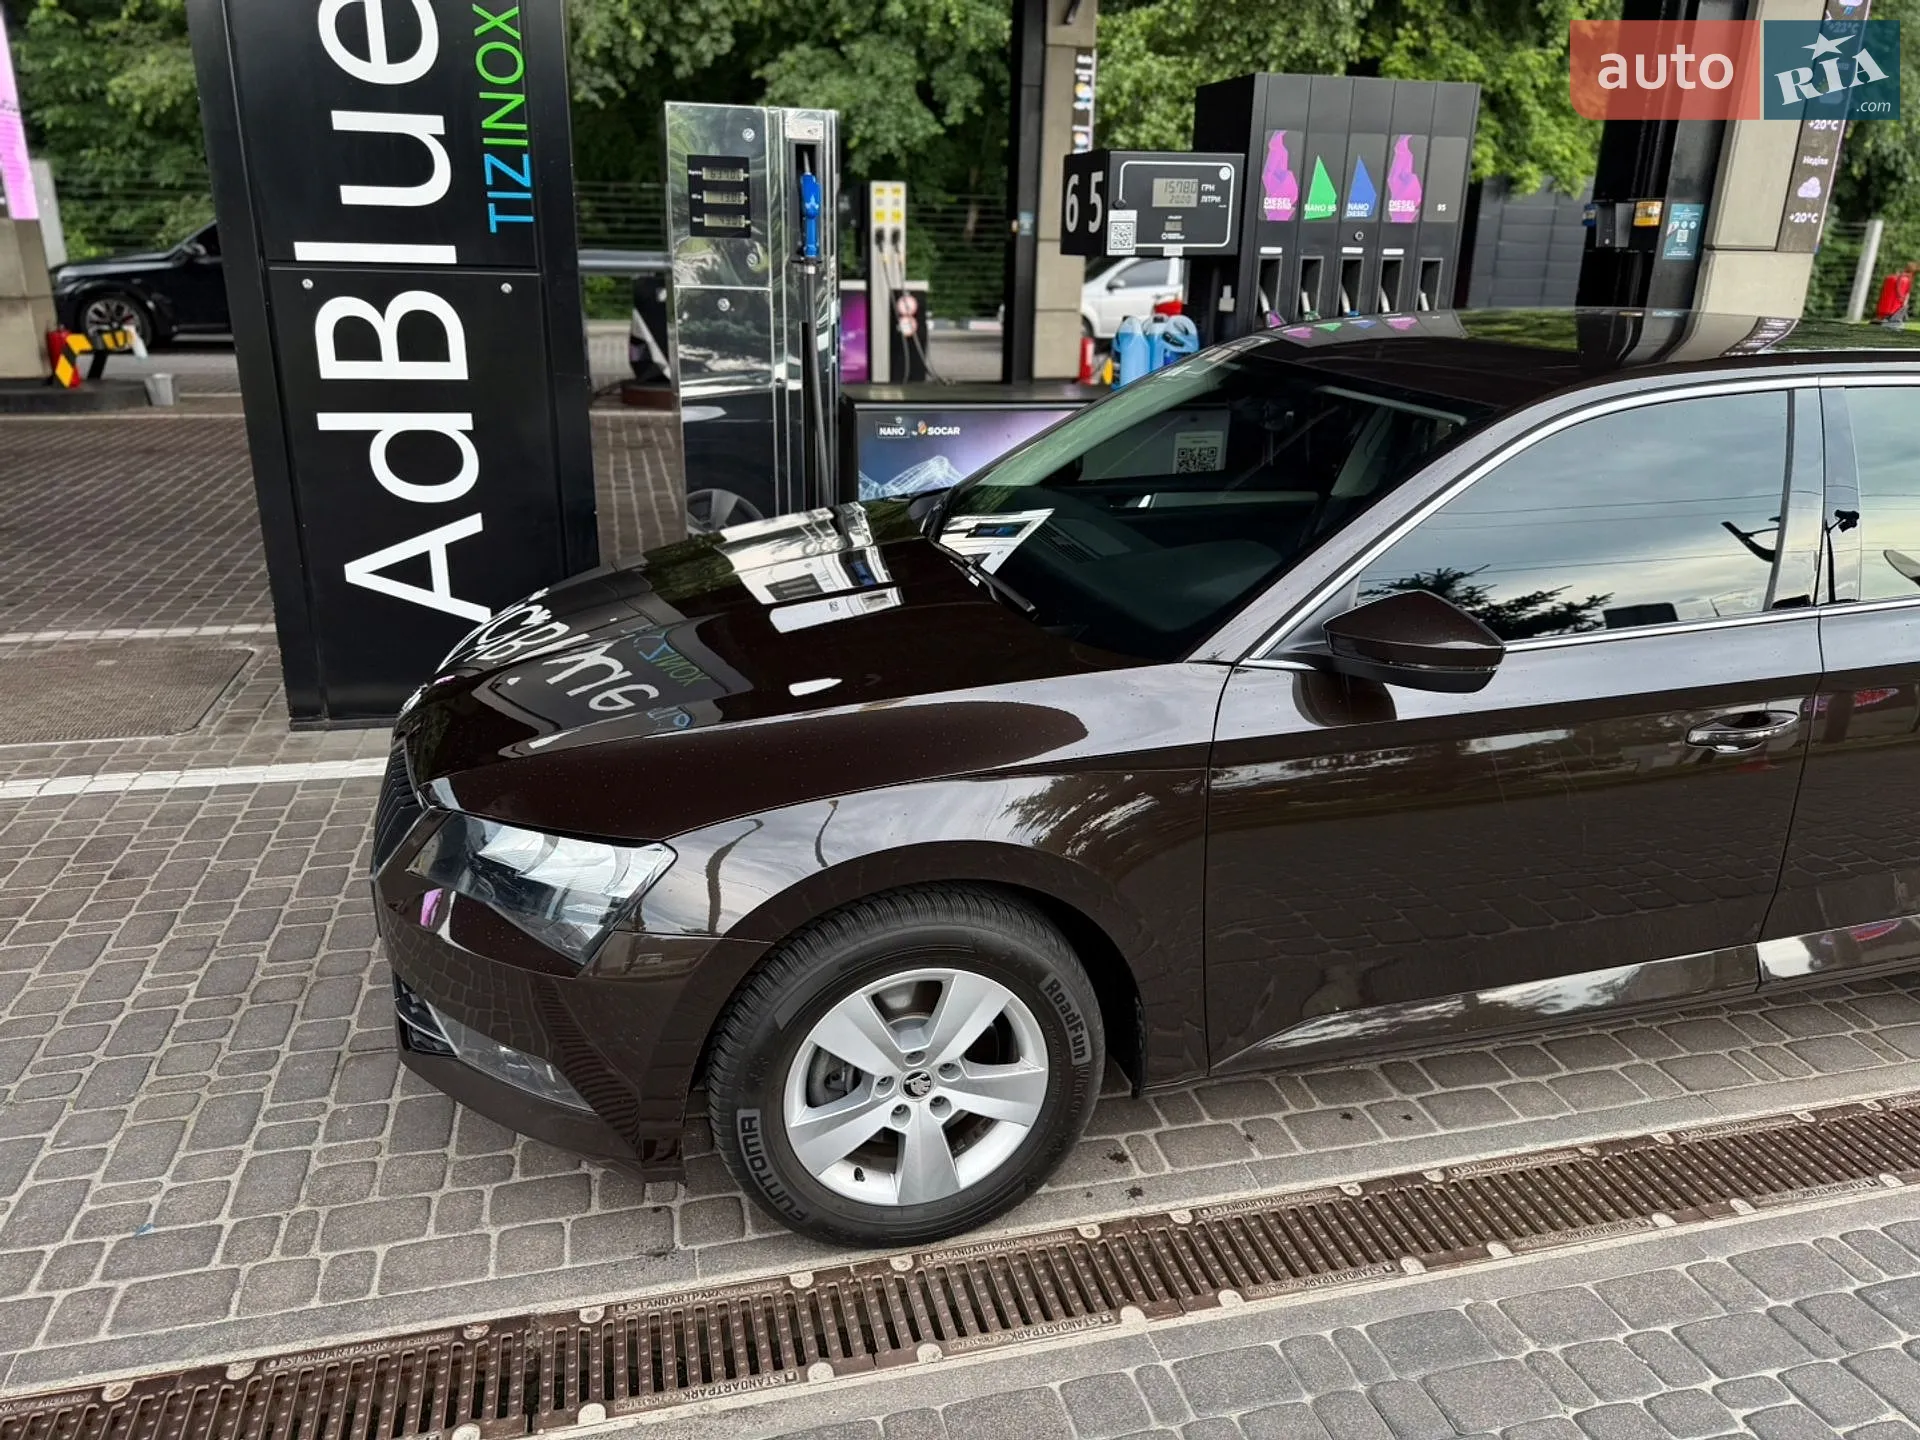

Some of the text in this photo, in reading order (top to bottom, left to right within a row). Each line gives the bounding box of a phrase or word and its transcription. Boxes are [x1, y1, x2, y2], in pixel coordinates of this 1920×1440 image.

[472, 3, 534, 233] TIZINOX
[1346, 202, 1369, 211] NANO
[1789, 212, 1819, 223] +20°C
[294, 0, 492, 624] AdBlue
[879, 427, 905, 436] NANO
[927, 427, 961, 436] SOCAR
[1044, 978, 1087, 1060] RoadFun
[740, 1115, 809, 1221] FUNTOMA
[682, 1374, 781, 1400] STANDARTPARK
